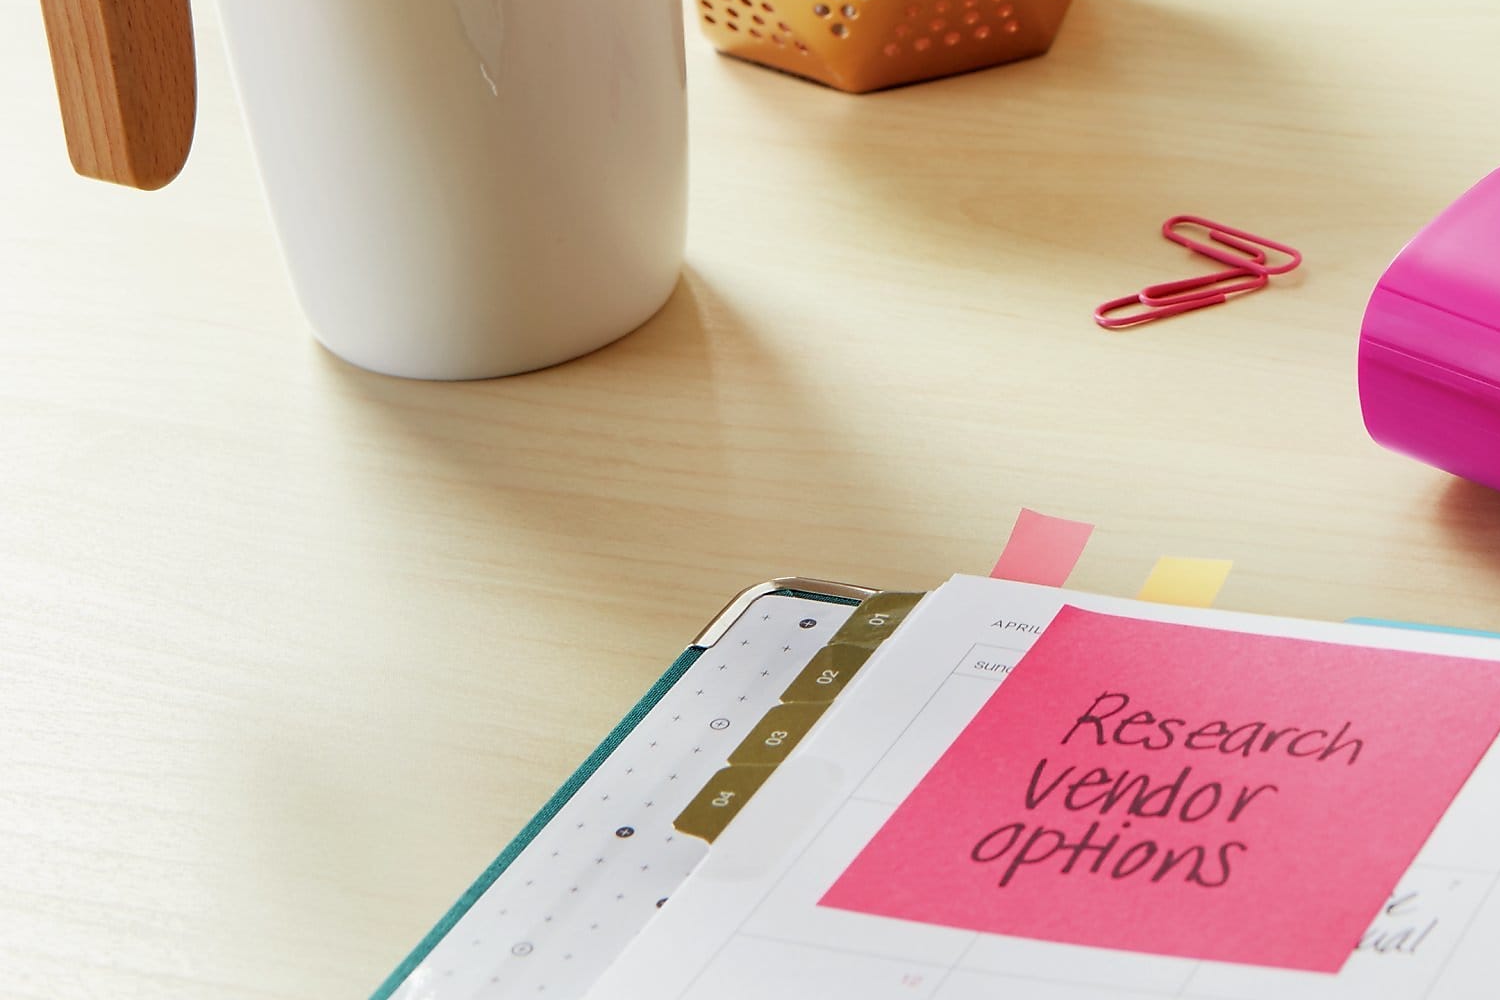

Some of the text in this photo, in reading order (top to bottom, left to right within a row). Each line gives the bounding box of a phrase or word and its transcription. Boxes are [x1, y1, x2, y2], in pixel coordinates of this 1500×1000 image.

[868, 612, 890, 627] 01
[990, 619, 1041, 635] APRIL
[815, 668, 840, 686] 02
[1061, 691, 1364, 766] Research
[765, 730, 788, 747] 03
[1025, 757, 1279, 823] vendor
[711, 791, 736, 807] 04
[970, 821, 1248, 888] options
